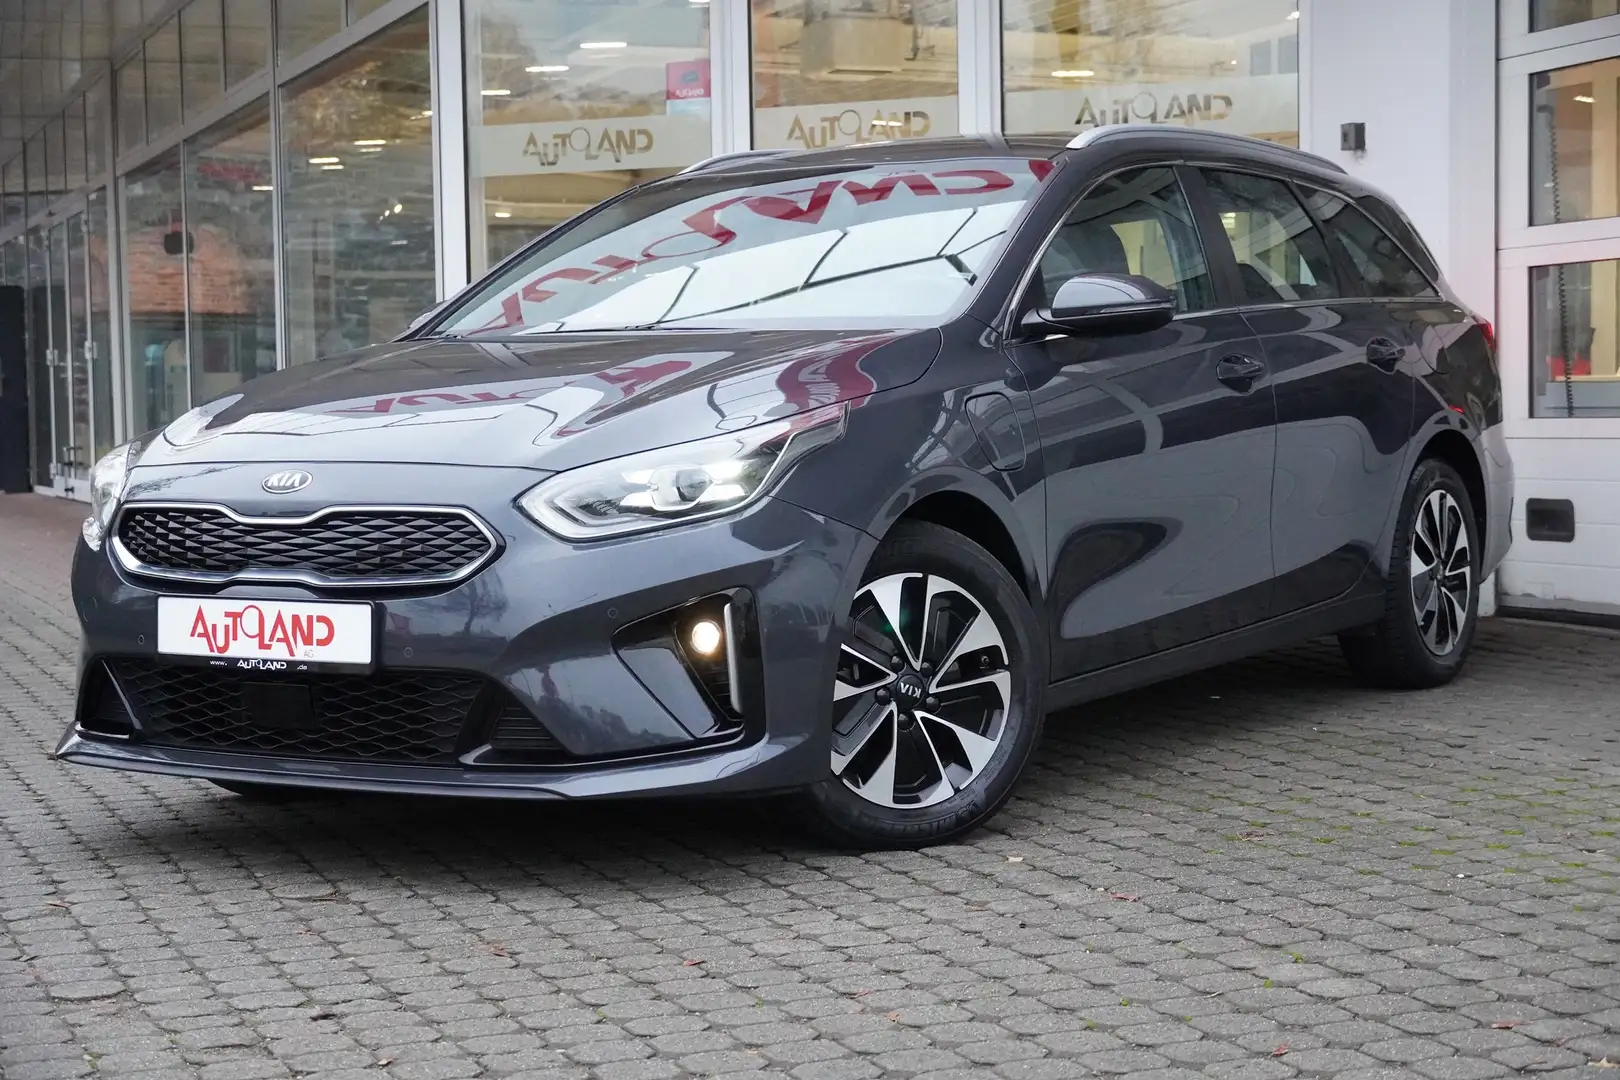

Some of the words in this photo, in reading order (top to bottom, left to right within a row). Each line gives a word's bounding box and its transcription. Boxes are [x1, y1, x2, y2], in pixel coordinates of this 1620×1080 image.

[522, 127, 654, 167] AUTOLAND
[787, 109, 931, 149] AUTOLAND
[190, 604, 335, 657] AUTOLAND
[237, 658, 287, 670] AUTOLAND
[900, 682, 921, 698] KIA
